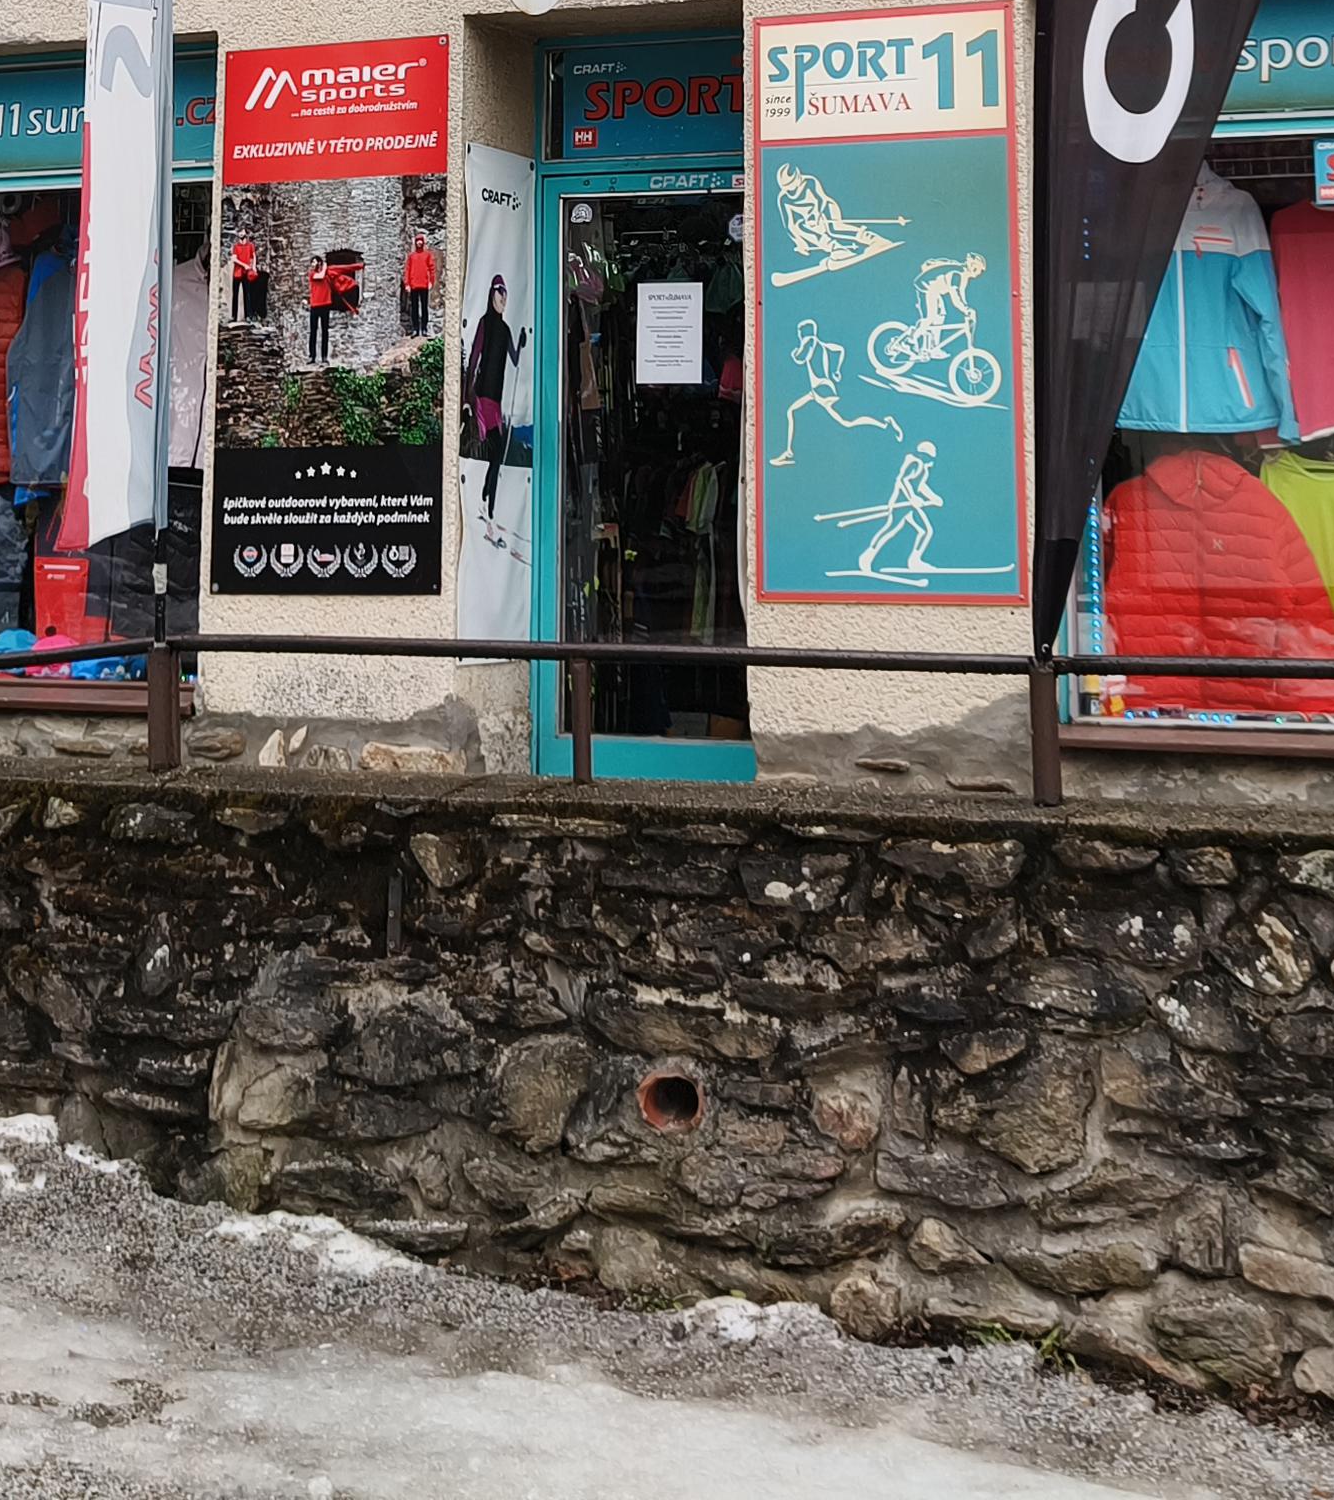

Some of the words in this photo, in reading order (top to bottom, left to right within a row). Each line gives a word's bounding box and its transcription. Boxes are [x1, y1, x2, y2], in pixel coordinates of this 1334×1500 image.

[301, 62, 419, 87] maier
[573, 62, 615, 75] CRAFT
[767, 37, 915, 124] SPORT
[921, 28, 1000, 111] 11
[301, 83, 406, 103] sports
[583, 74, 744, 122] SPORT
[300, 107, 312, 117] na
[313, 104, 336, 116] cestě
[336, 105, 347, 114] za
[348, 100, 418, 114] dobrodružstvím
[764, 93, 793, 106] since
[806, 91, 912, 117] ŠUMAVA
[764, 106, 792, 119] 1999
[232, 139, 315, 160] EXKLUZIVNĚ
[316, 142, 327, 154] V
[326, 136, 364, 153] TÉTO
[365, 129, 439, 151] PRODEJNĚ
[480, 186, 512, 205] CRAFT
[223, 496, 267, 511] špičkové
[268, 495, 328, 509] outdoorové
[380, 494, 408, 508] které
[409, 494, 434, 508] Vám
[223, 512, 250, 525] bude
[250, 512, 283, 525] skvěle
[283, 512, 318, 525] sloužit
[318, 514, 332, 525] za
[333, 511, 376, 527] každých
[376, 510, 430, 527] podmínek
